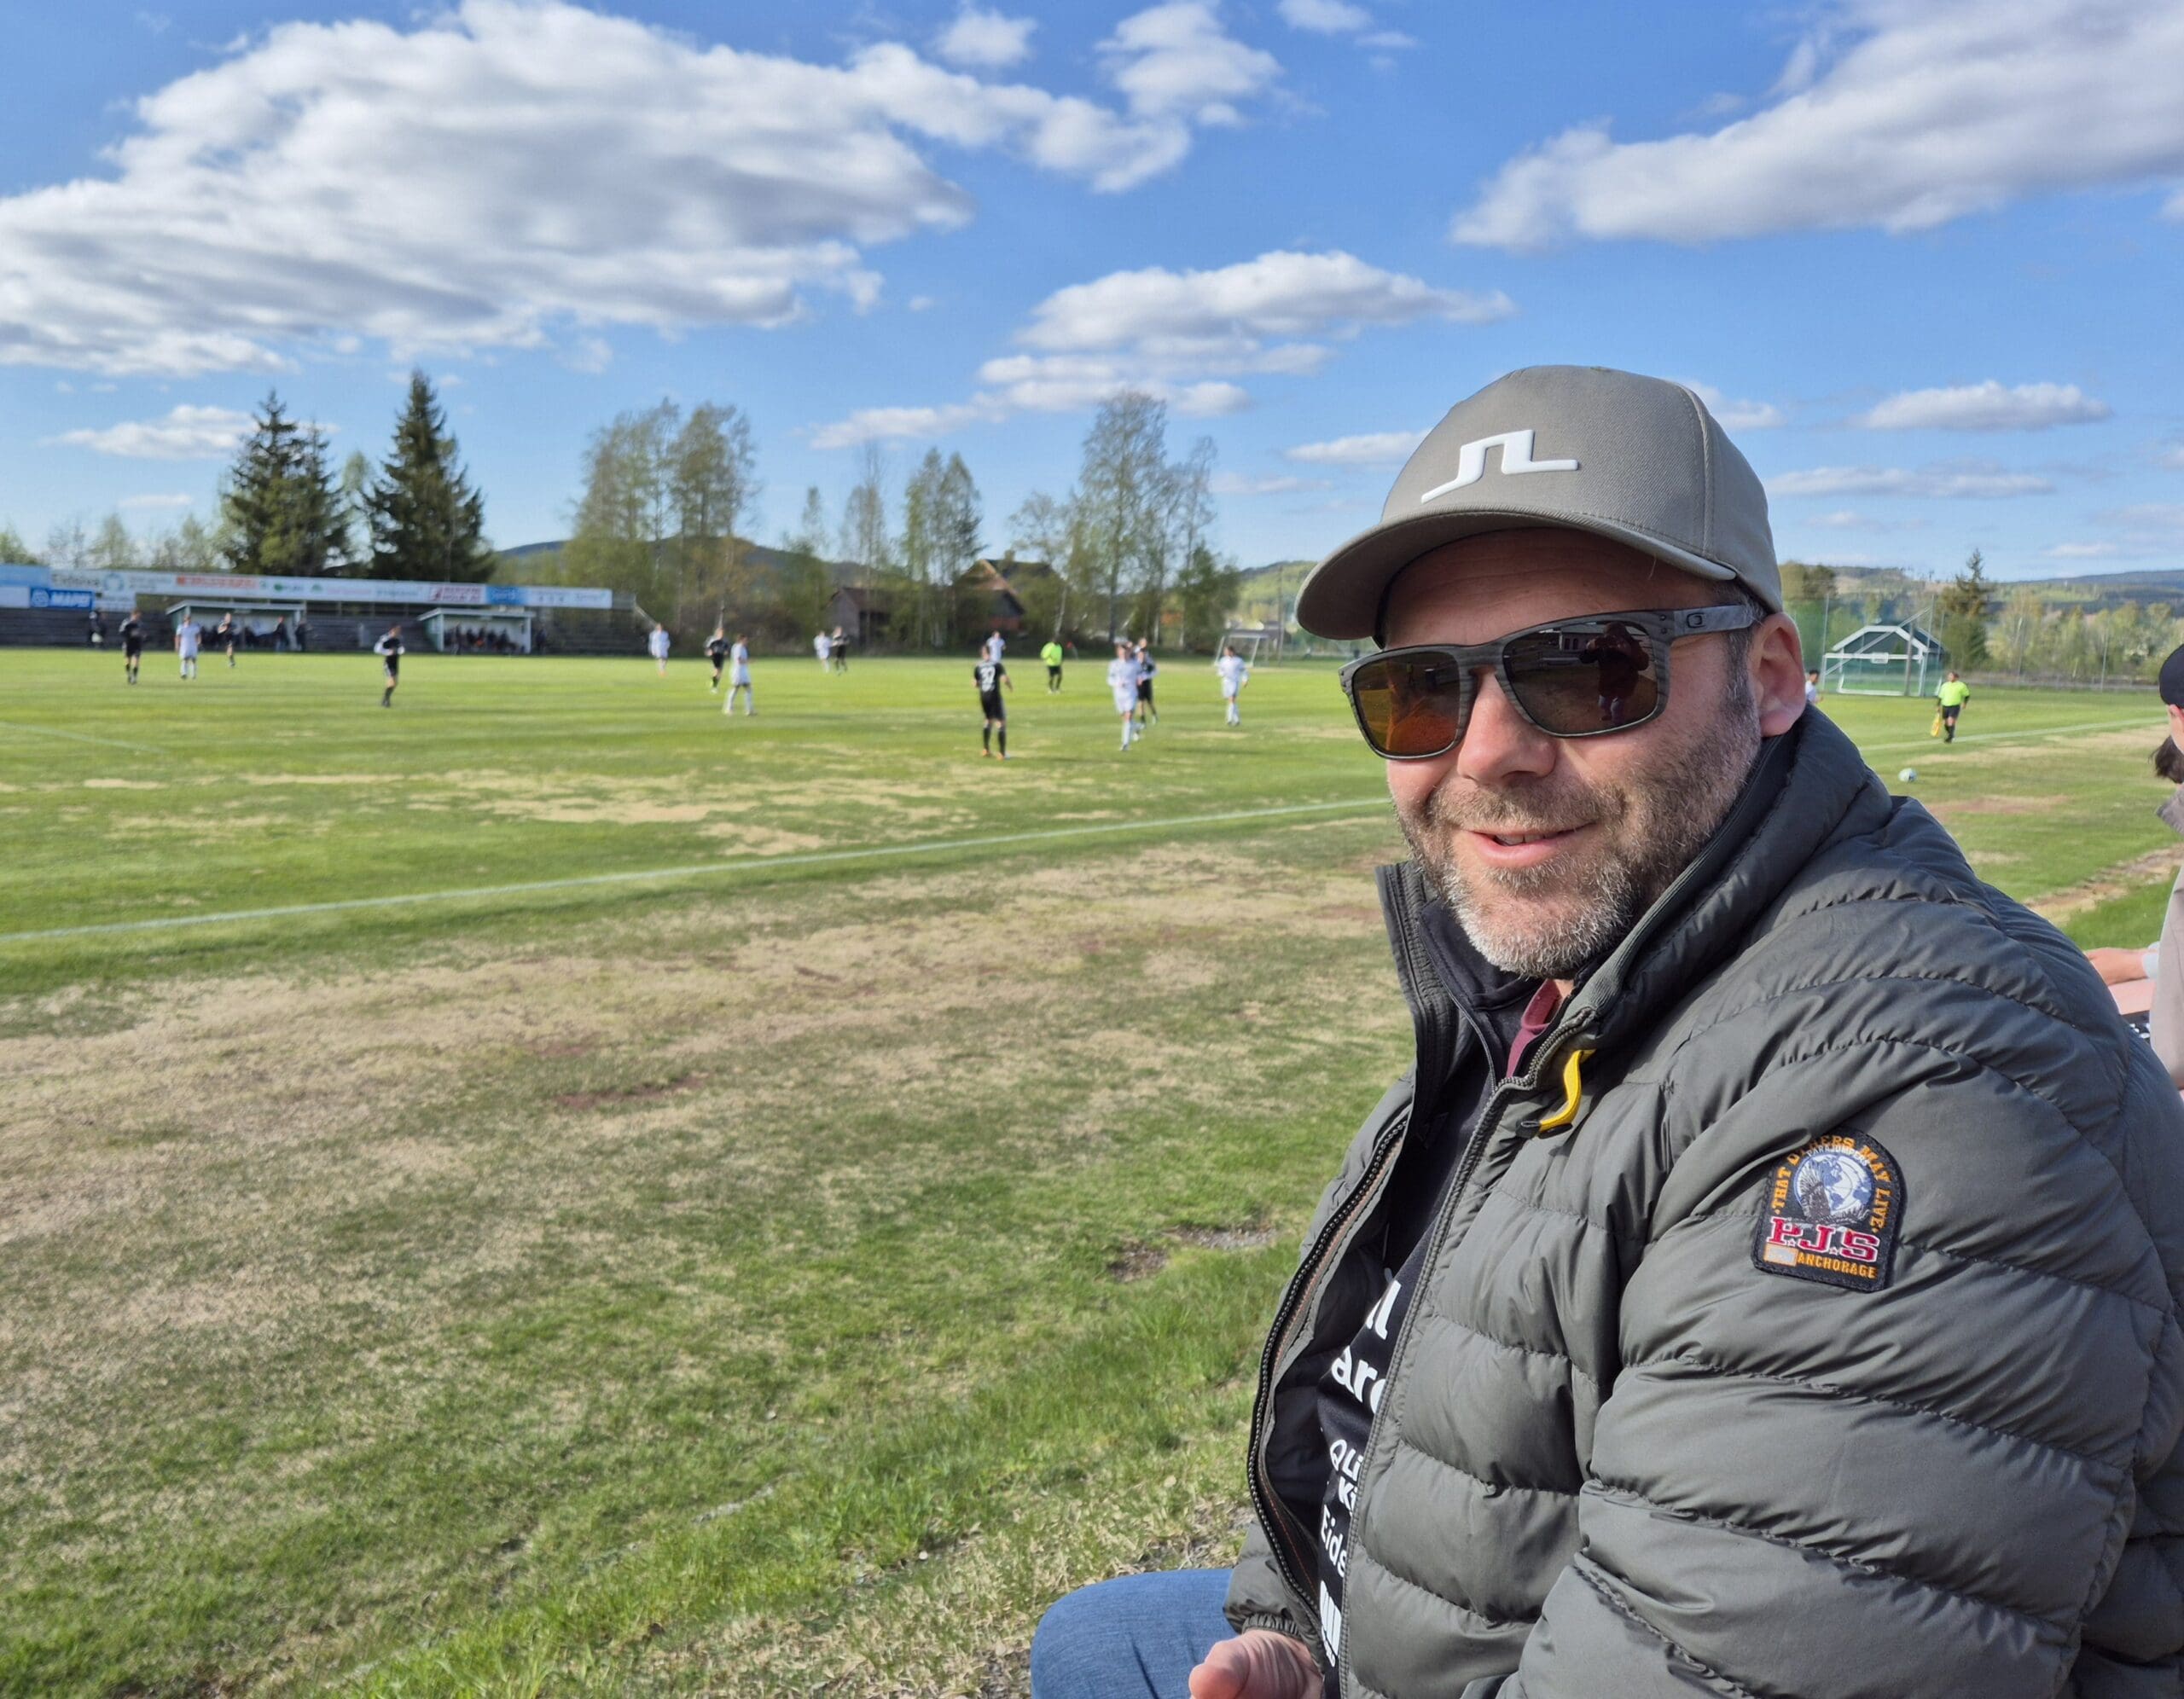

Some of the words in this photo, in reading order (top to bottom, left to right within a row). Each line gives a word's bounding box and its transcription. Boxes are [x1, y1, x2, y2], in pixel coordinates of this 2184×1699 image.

[1860, 1145, 1891, 1182] MAY
[1771, 1166, 1792, 1209] THAT
[1869, 1187, 1891, 1228] LIVE
[1798, 1252, 1877, 1279] ANCHORAGE
